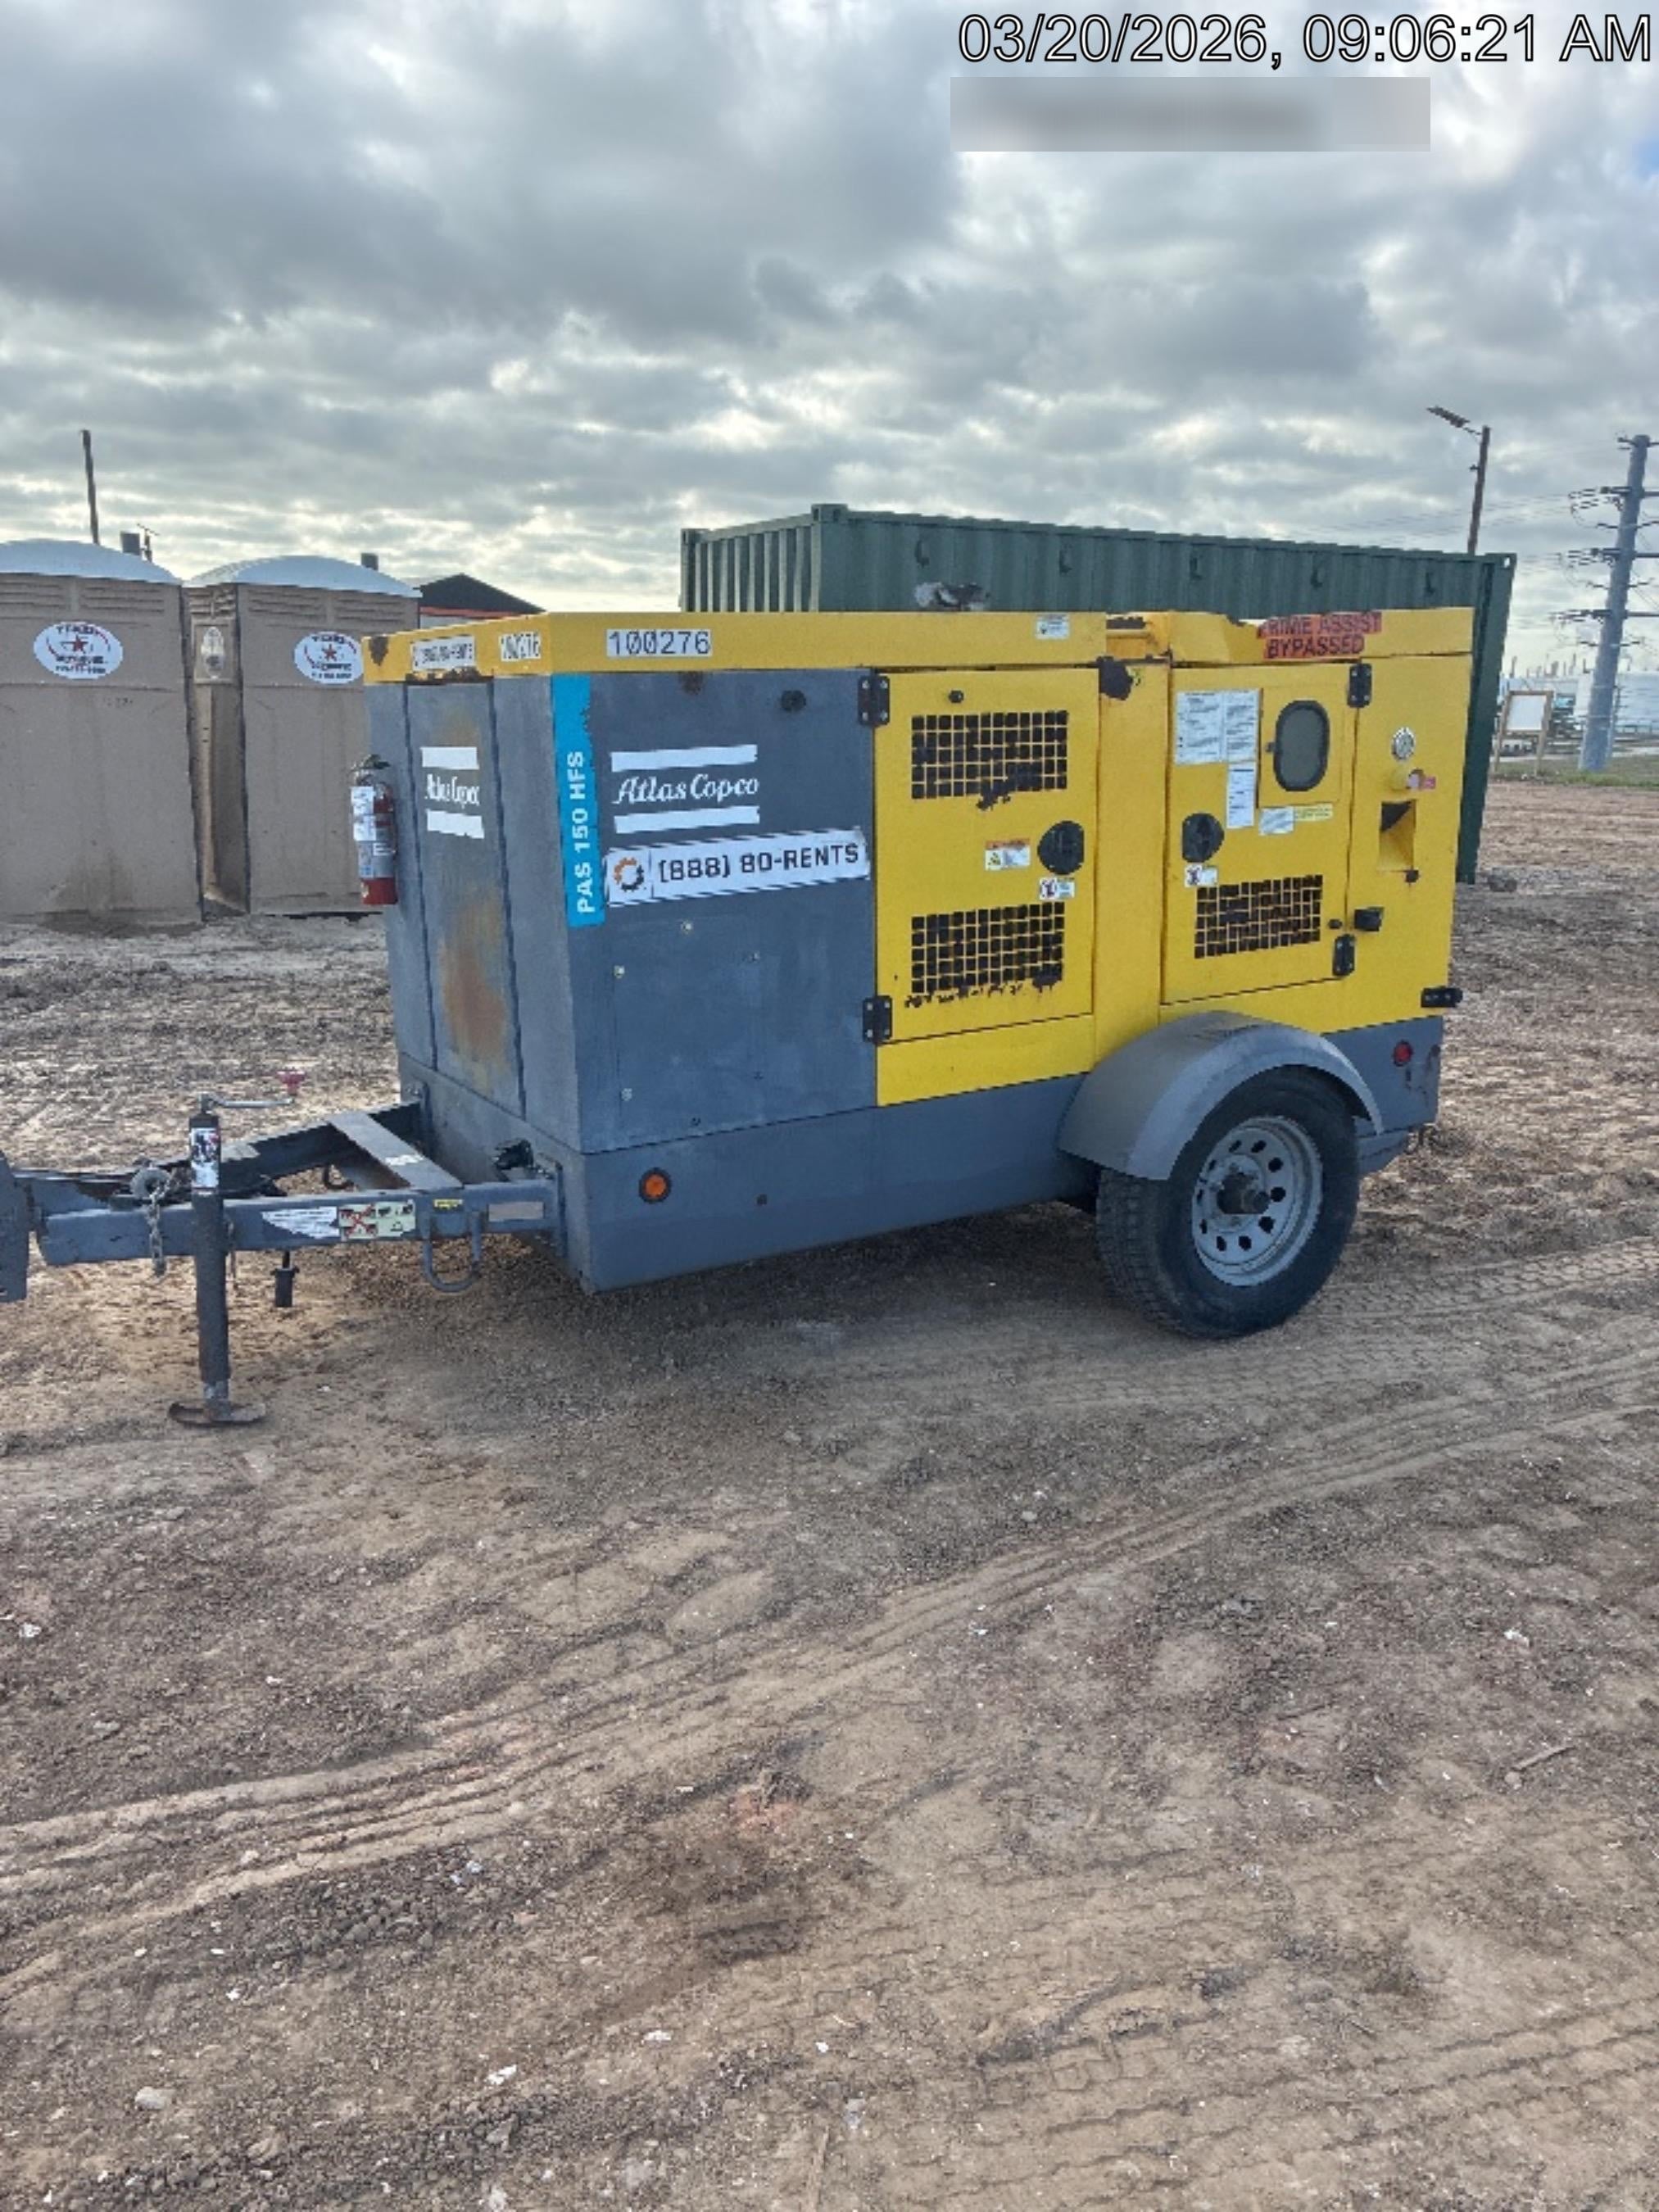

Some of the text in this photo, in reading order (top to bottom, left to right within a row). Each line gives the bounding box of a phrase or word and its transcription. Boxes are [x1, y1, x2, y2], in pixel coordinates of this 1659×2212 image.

[609, 631, 710, 655] 100276
[1267, 632, 1365, 660] BYPASSED
[612, 773, 759, 805] Atlas Copco
[566, 750, 596, 913] PAS 150 HFS
[658, 842, 859, 883] (888) 80-RENTS
